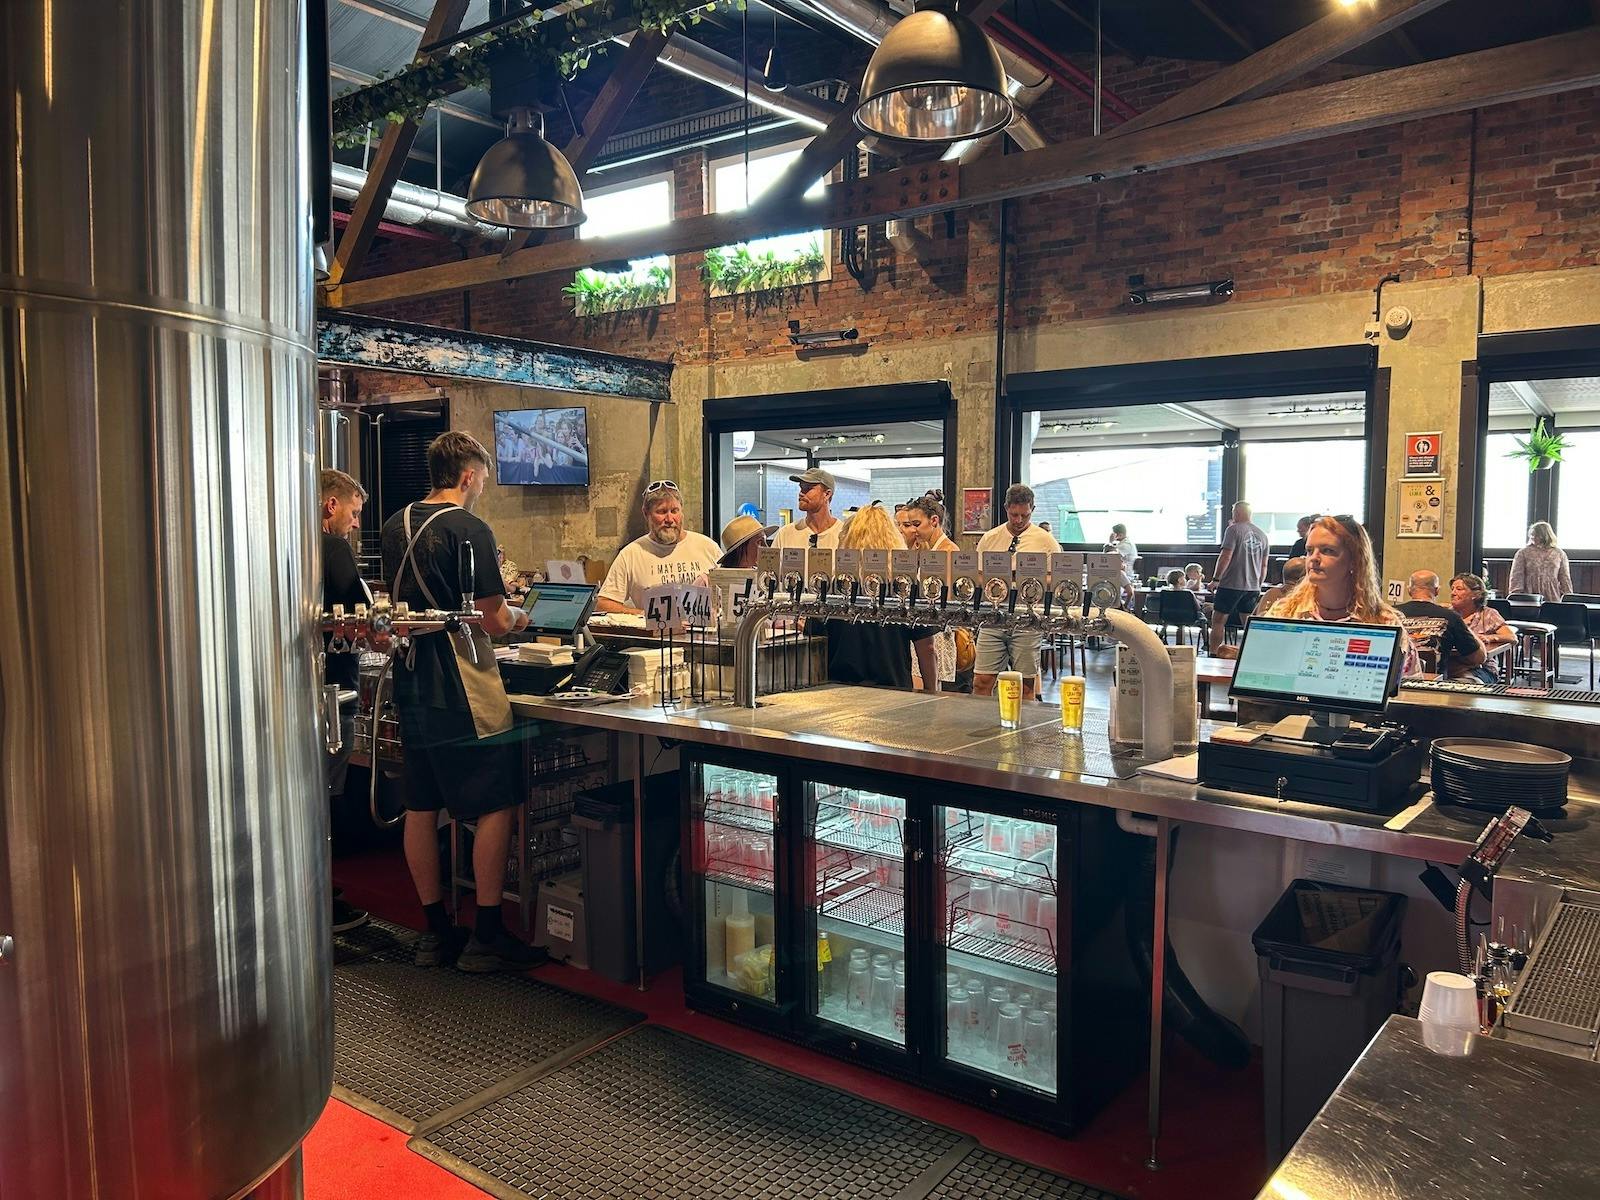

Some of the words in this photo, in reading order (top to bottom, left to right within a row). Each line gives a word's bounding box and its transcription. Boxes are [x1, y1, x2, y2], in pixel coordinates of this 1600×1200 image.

[657, 563, 673, 574] MAY
[677, 562, 687, 573] BE
[690, 561, 701, 571] AN
[678, 572, 696, 584] MAN
[1388, 583, 1401, 597] 20
[647, 595, 672, 622] 47
